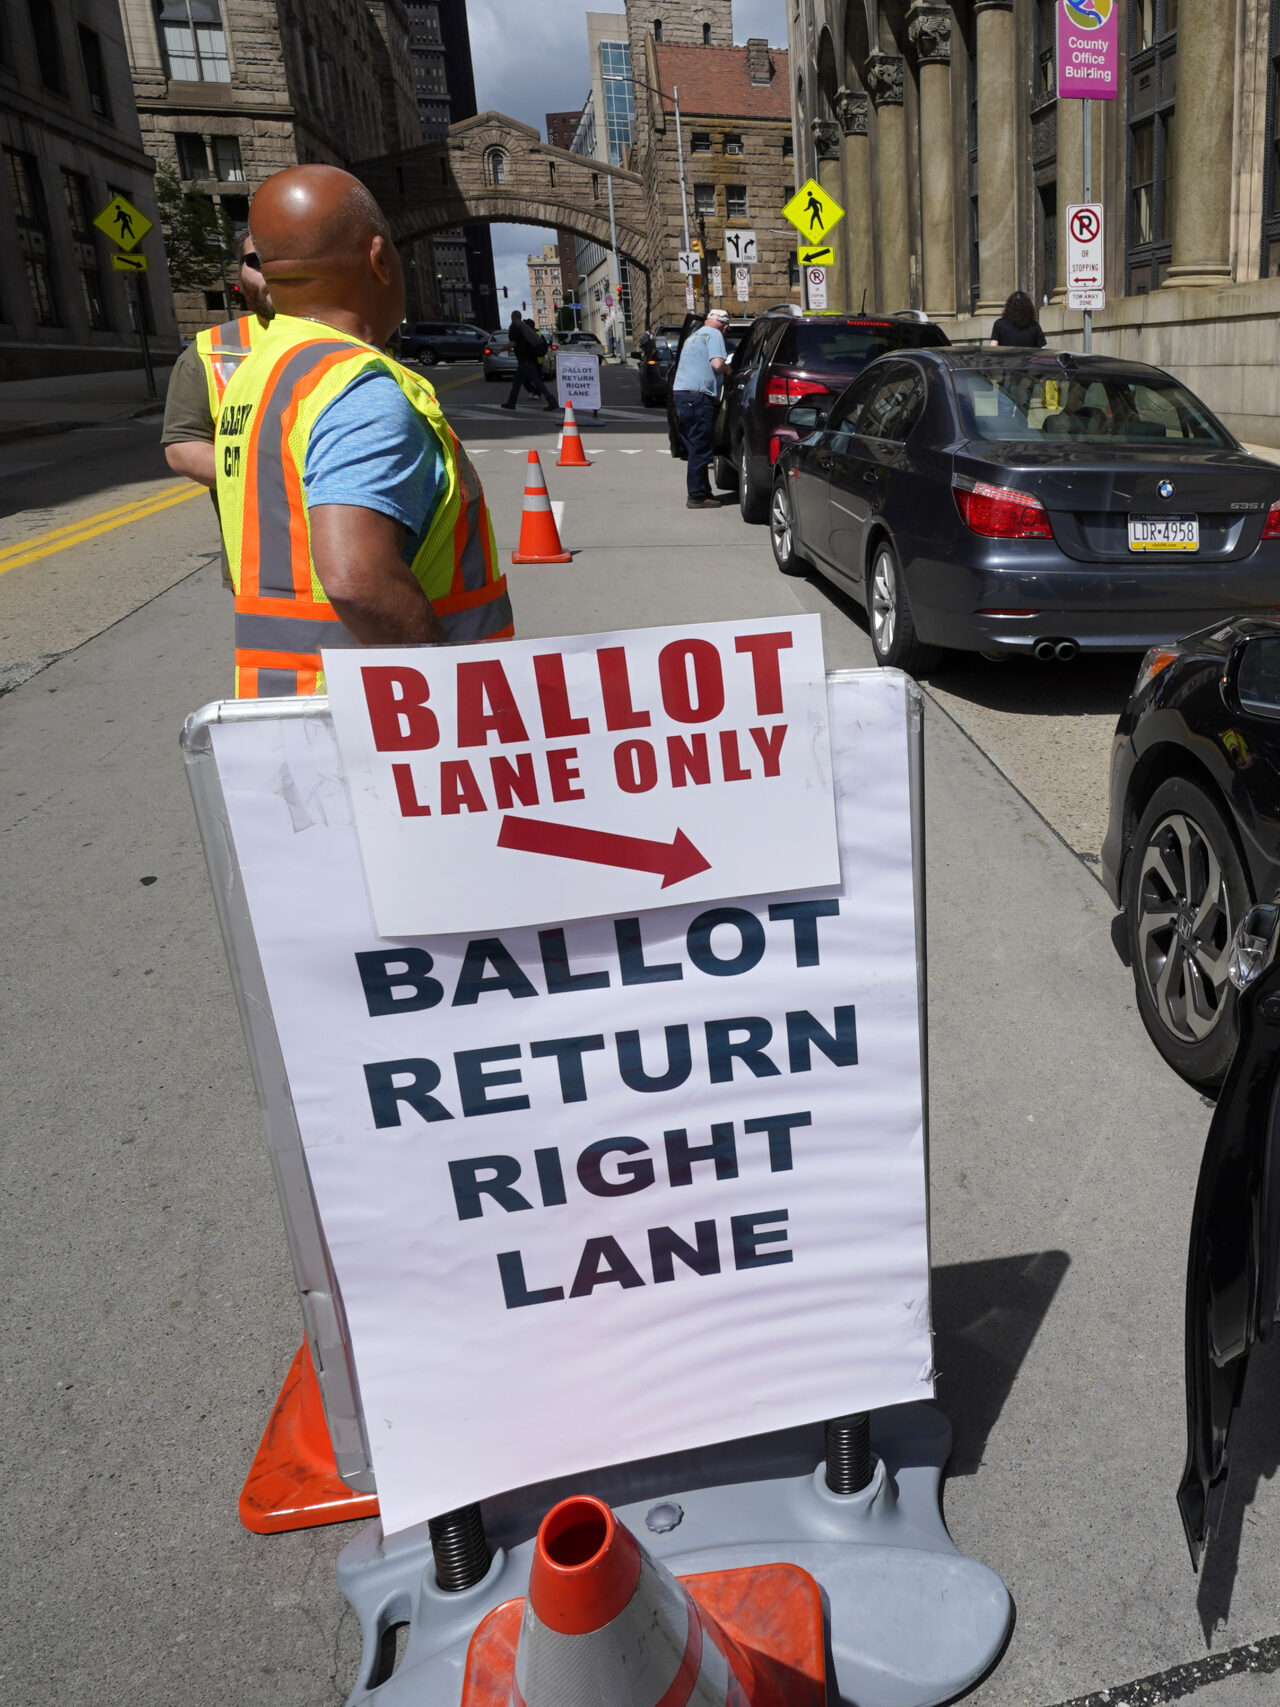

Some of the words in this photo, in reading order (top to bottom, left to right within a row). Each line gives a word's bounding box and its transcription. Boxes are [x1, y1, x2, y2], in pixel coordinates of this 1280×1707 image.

[1065, 65, 1112, 82] Building
[1068, 36, 1109, 53] County
[1072, 51, 1105, 65] Office
[1072, 263, 1099, 272] STOPPING
[1081, 249, 1089, 258] OR
[361, 631, 793, 752] BALLOT
[392, 748, 585, 817] LANE
[613, 724, 788, 794] ONLY
[355, 898, 840, 1017] BALLOT
[363, 1004, 859, 1130] RETURN
[448, 1110, 812, 1221] RIGHT
[496, 1208, 794, 1309] LANE
